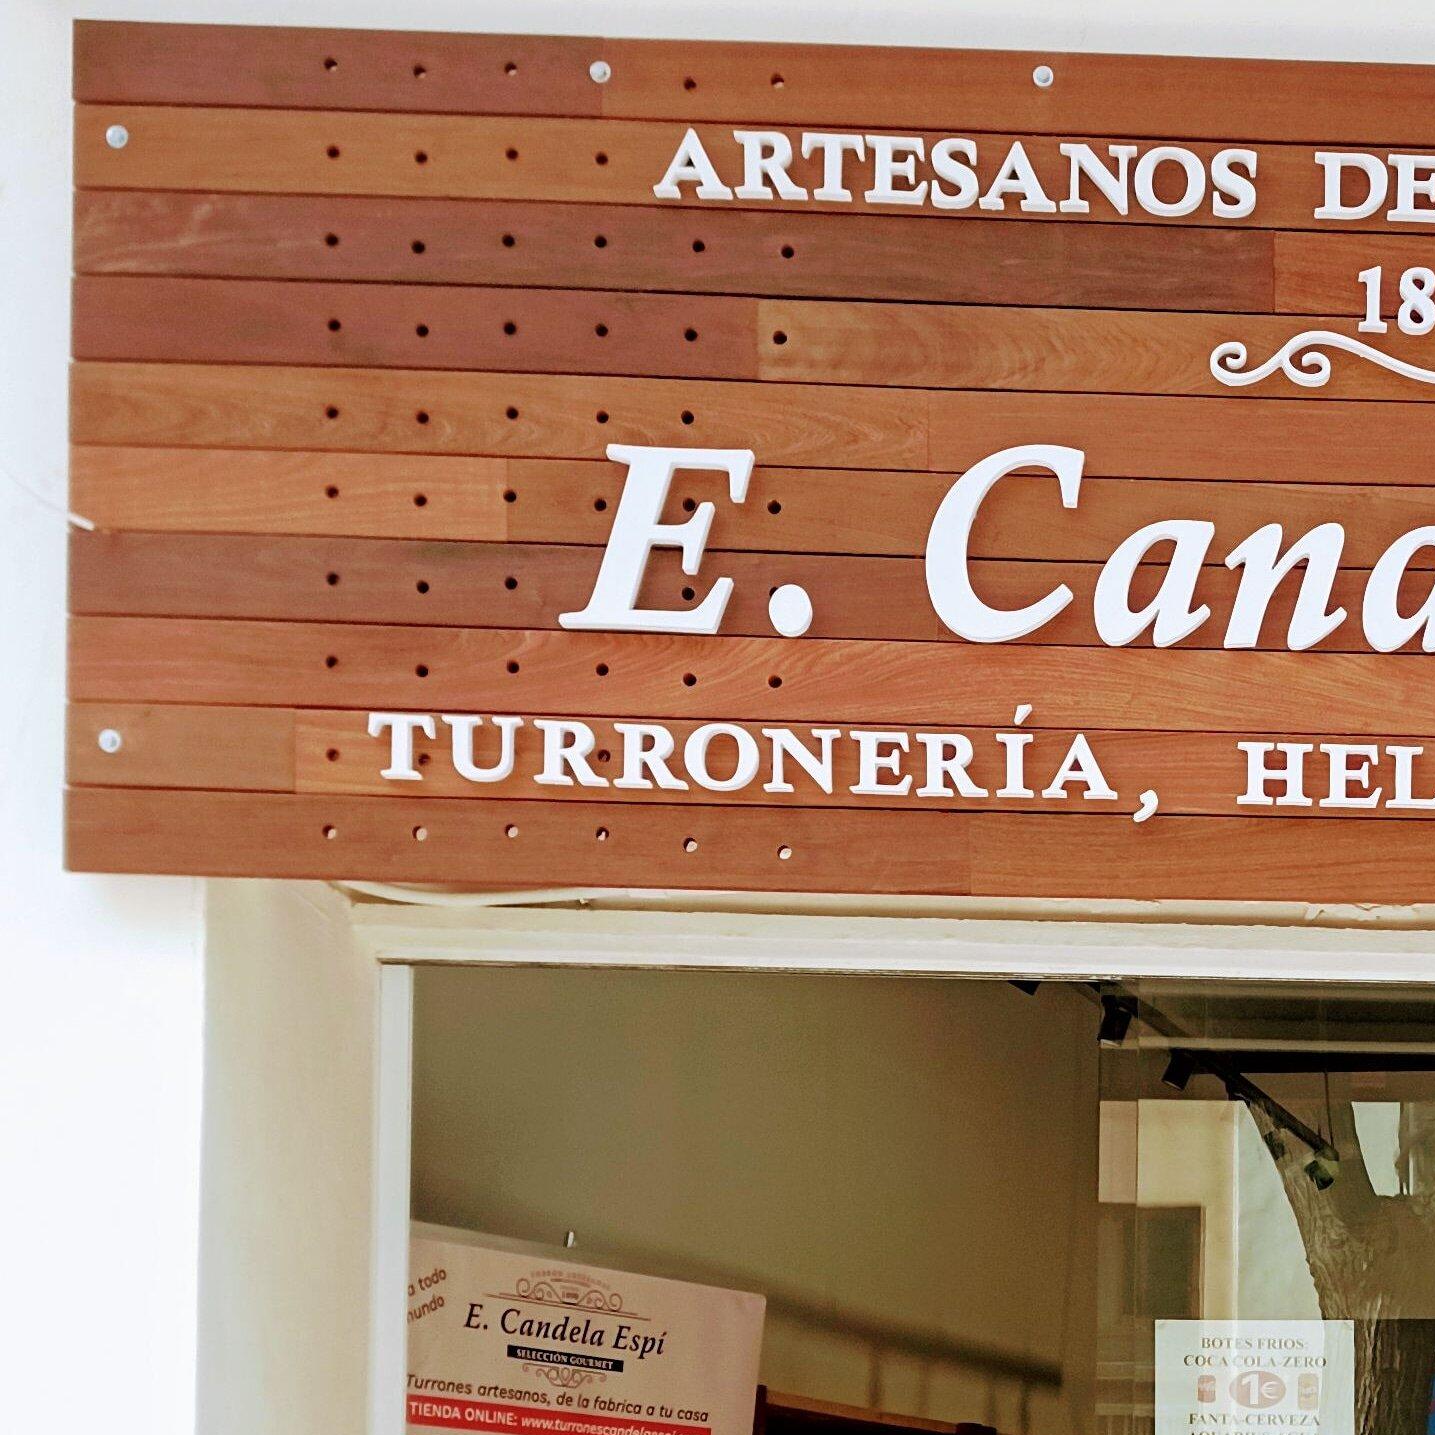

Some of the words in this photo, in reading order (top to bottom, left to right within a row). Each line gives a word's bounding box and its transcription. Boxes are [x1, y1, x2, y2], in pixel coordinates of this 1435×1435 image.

[653, 127, 1258, 219] ARTESANOS
[558, 442, 813, 637] E.
[367, 703, 1159, 823] TURRONERÍA,
[407, 1284, 416, 1297] a
[418, 1269, 448, 1290] todo
[463, 1303, 489, 1330] E.
[501, 1308, 604, 1347] Candela
[612, 1325, 668, 1360] Espí
[1201, 1337, 1253, 1350] BOTES
[569, 1355, 614, 1371] GOURMET
[1183, 1354, 1229, 1368] COCA
[406, 1374, 473, 1395] Turrones
[477, 1385, 551, 1406] artesanos,
[556, 1391, 574, 1407] de
[577, 1394, 589, 1409] la
[593, 1396, 642, 1415] fabrica
[646, 1405, 656, 1417] a
[659, 1404, 674, 1419] tu
[677, 1408, 709, 1422] casa
[410, 1401, 462, 1419] TIENDA
[464, 1407, 518, 1427] ONLINE:
[1188, 1412, 1322, 1427] FANTA-CERVEZA
